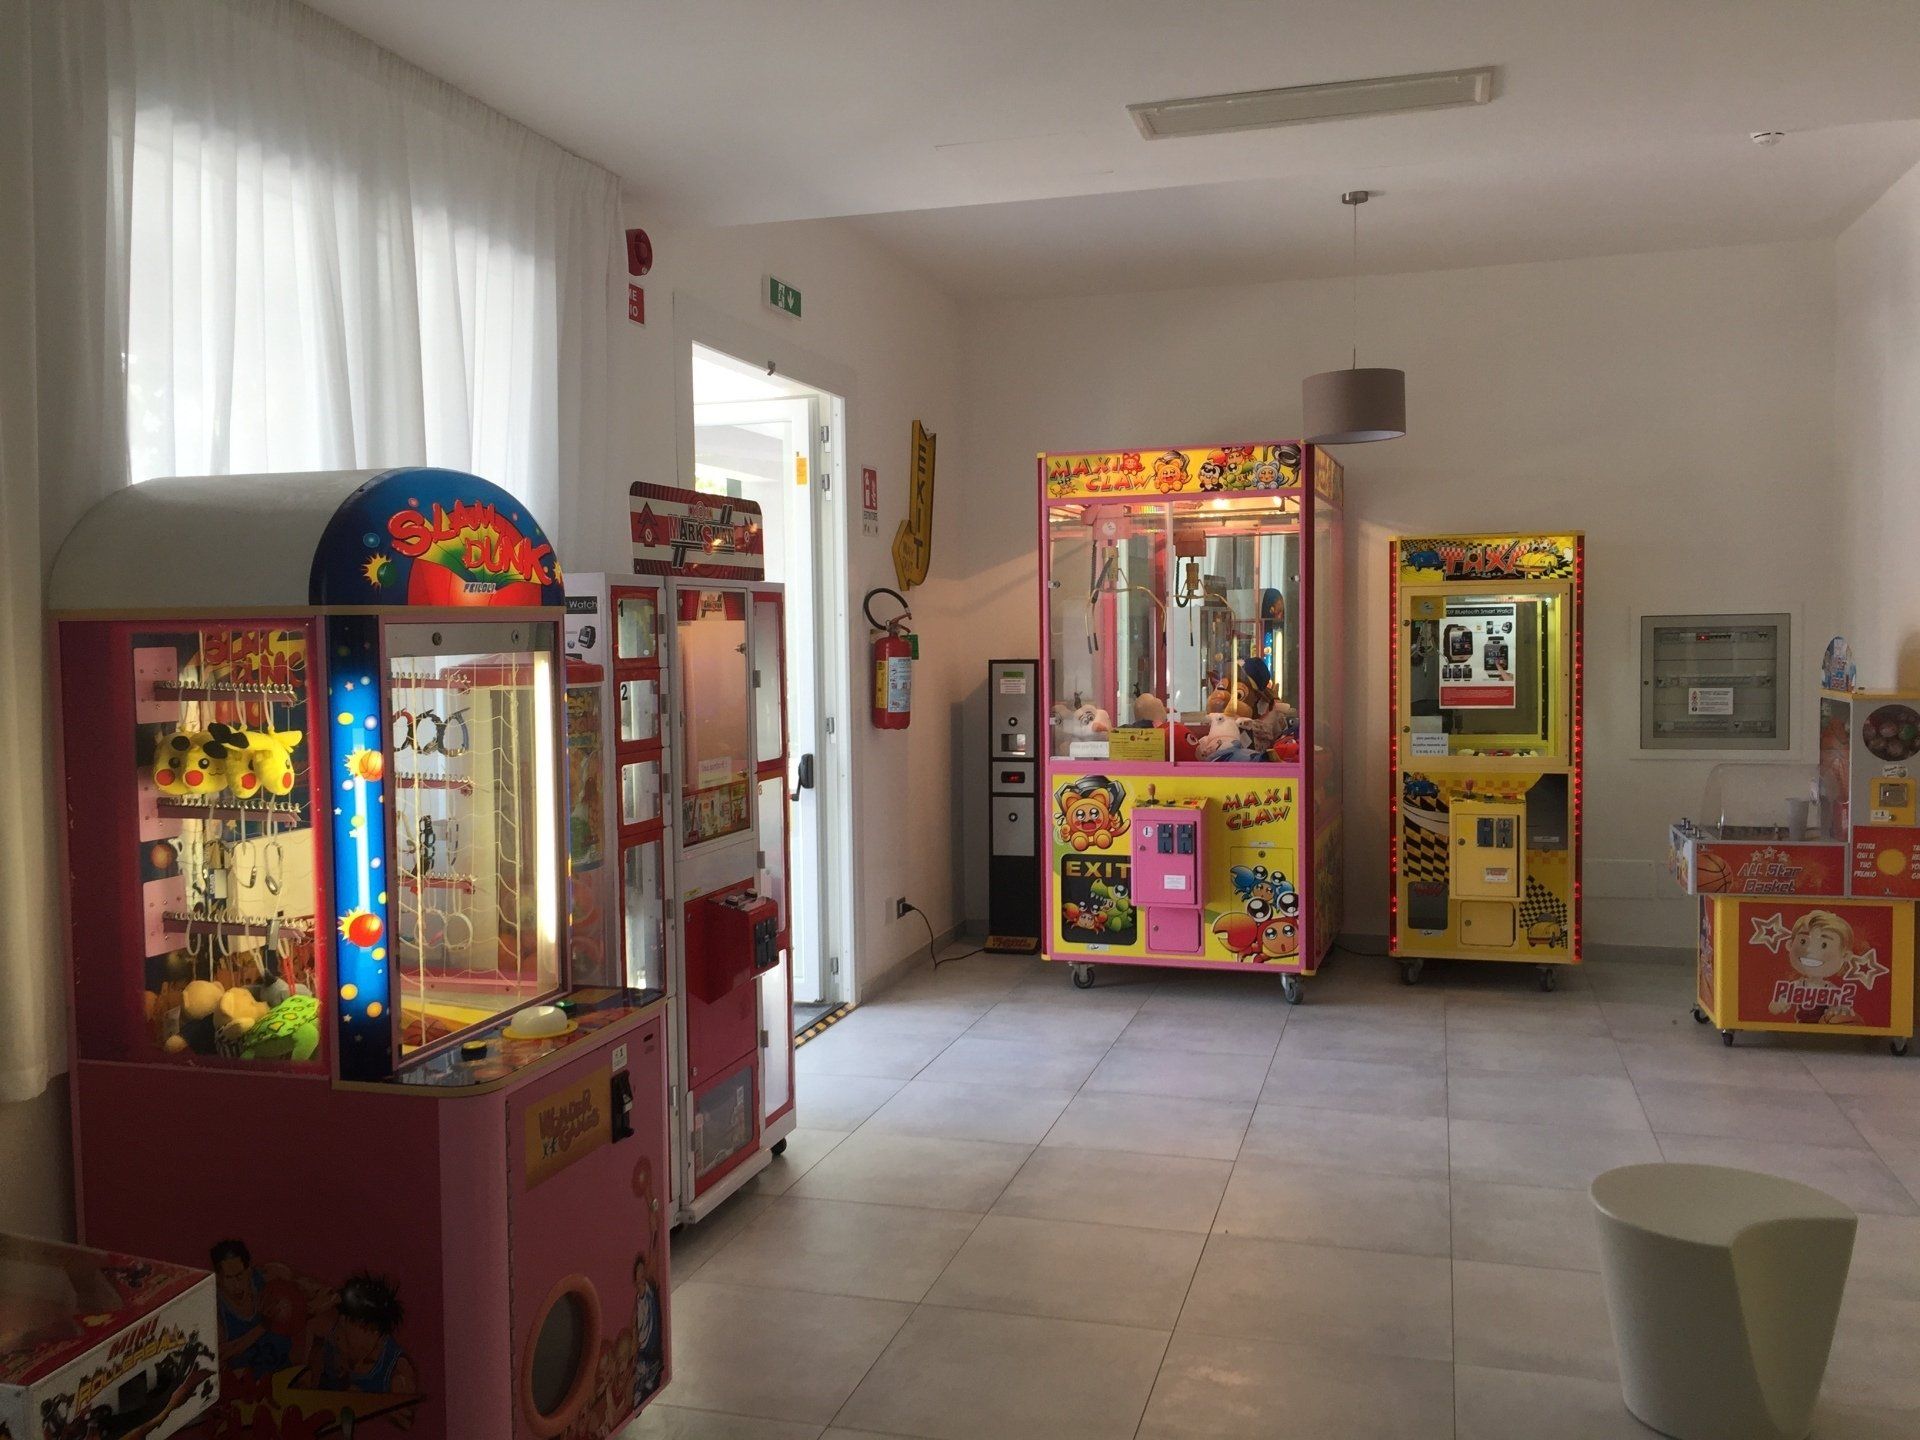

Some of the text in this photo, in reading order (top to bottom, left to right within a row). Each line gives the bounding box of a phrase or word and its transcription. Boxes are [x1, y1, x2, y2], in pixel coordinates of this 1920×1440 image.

[1049, 456, 1123, 479] MAXI
[1085, 474, 1151, 492] CLAW
[387, 499, 497, 557] SLAM
[462, 534, 552, 586] DUNK
[1438, 544, 1530, 576] TAXI
[569, 600, 598, 609] Watch
[621, 683, 628, 701] 2
[1222, 786, 1292, 812] MAXI
[1226, 806, 1291, 831] CLAW
[1066, 860, 1131, 878] EXIT
[1737, 862, 1802, 877] ALL Star
[1743, 878, 1796, 893] Basket
